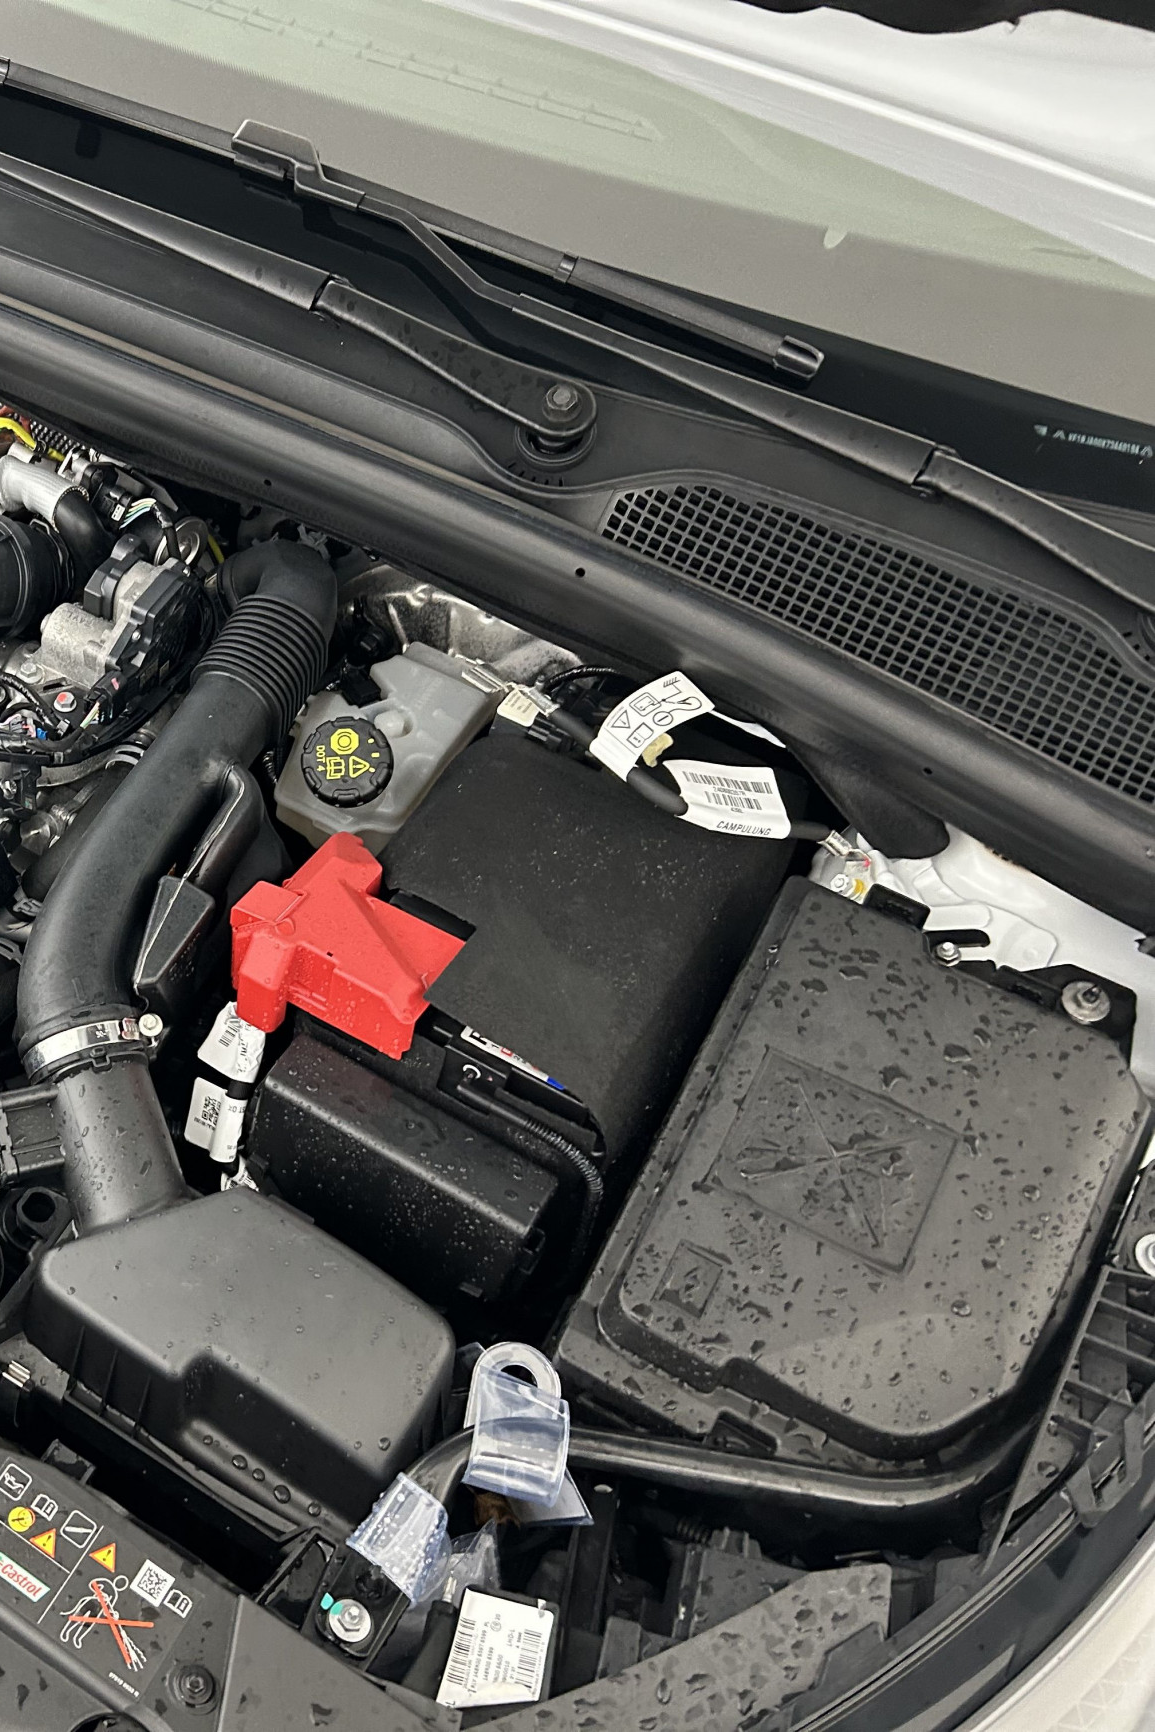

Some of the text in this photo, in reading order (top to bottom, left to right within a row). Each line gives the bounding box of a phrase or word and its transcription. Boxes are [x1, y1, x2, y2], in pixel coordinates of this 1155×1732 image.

[316, 745, 326, 763] DOT
[716, 820, 772, 836] CAMPULUNG
[1, 1563, 43, 1597] Castrol
